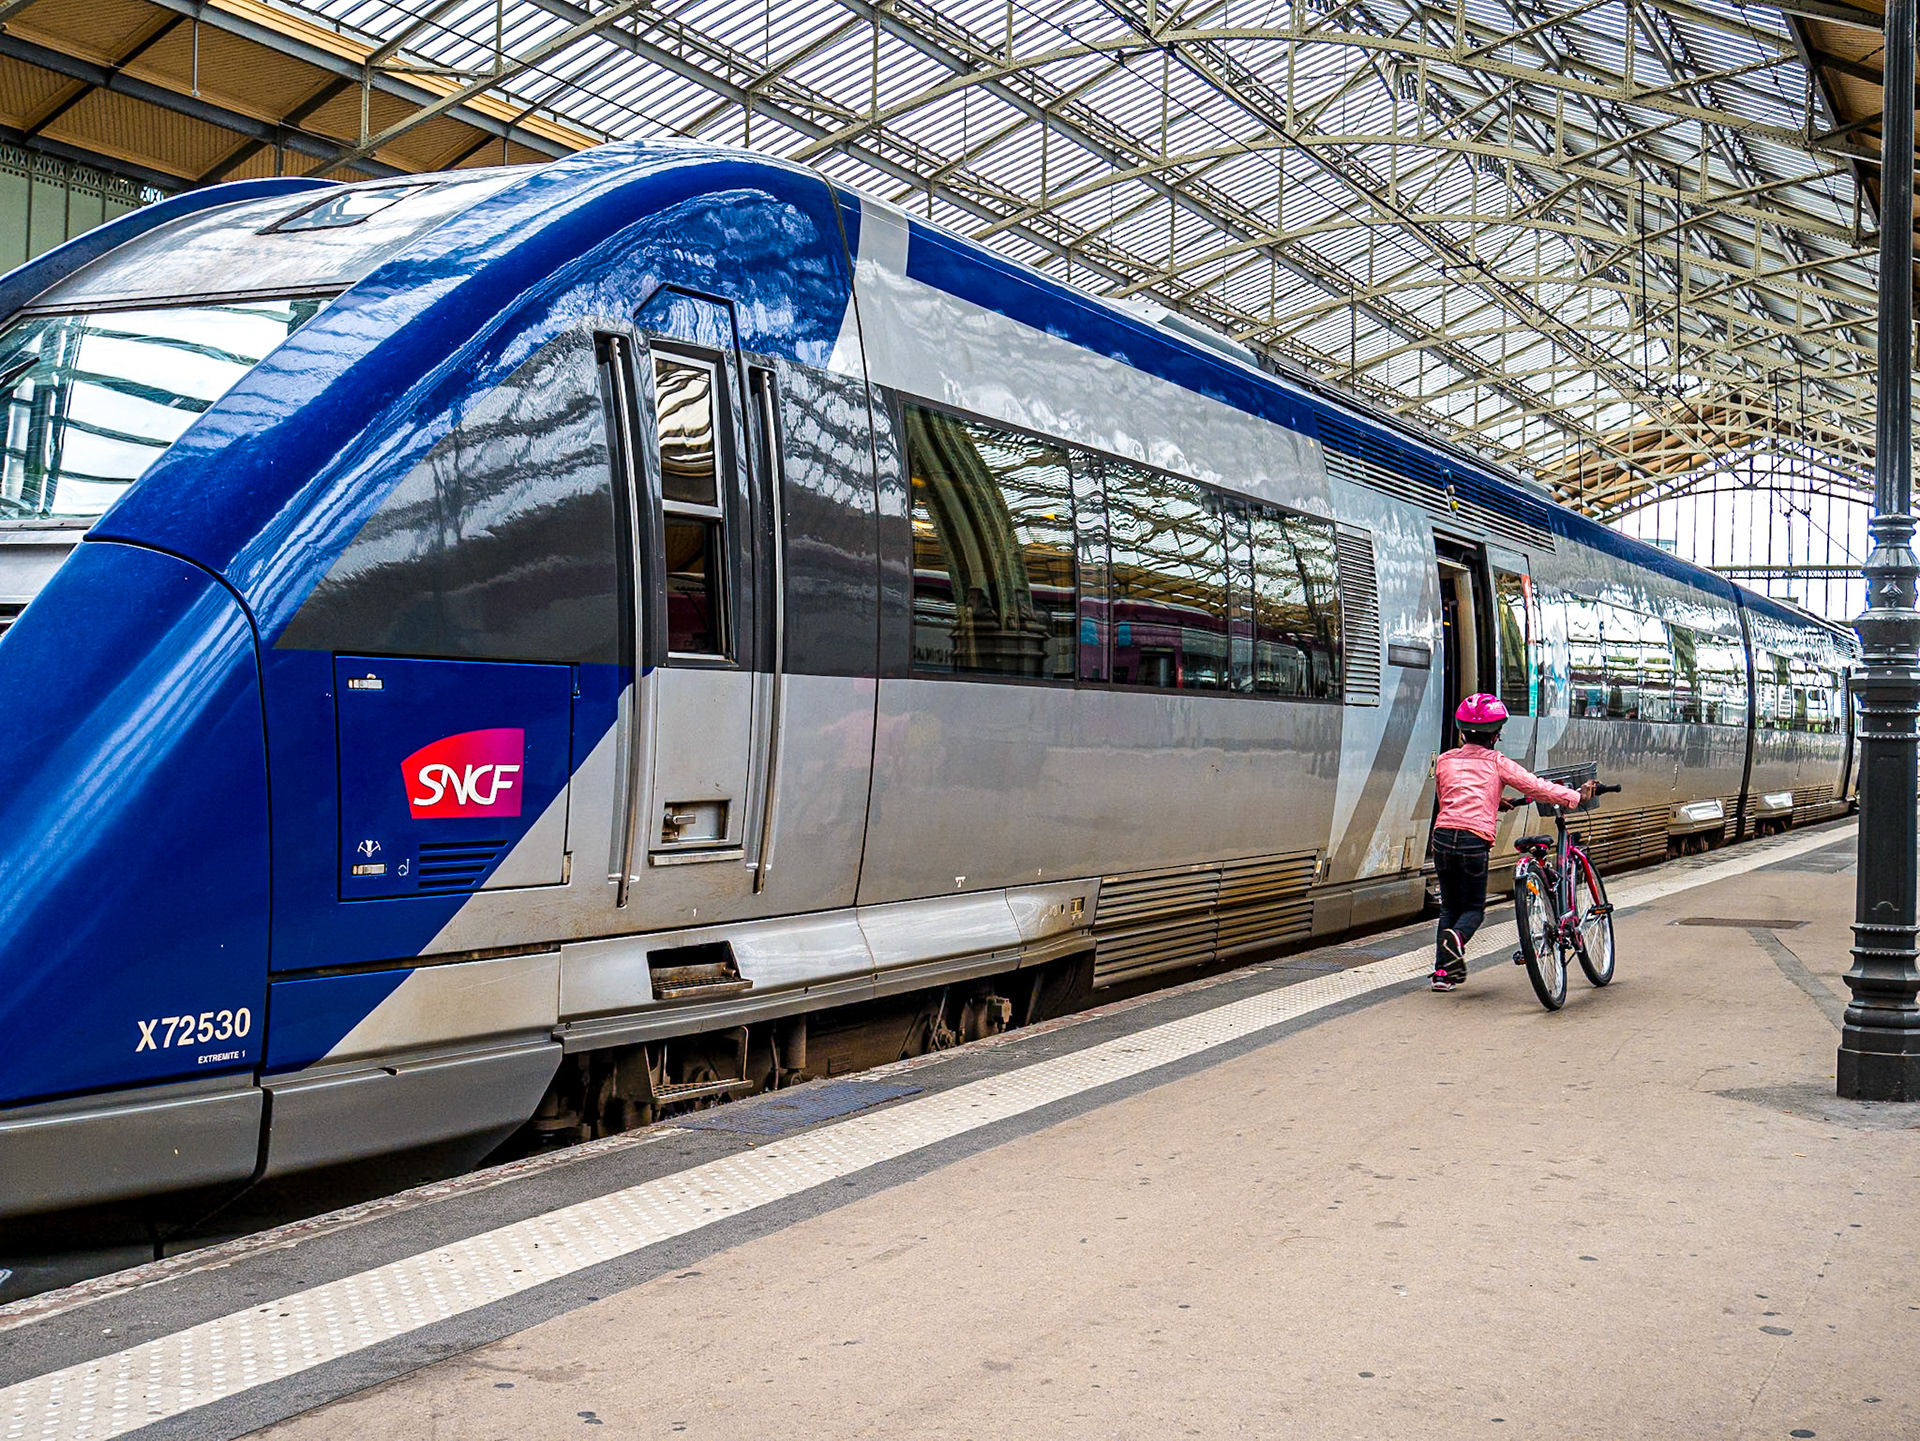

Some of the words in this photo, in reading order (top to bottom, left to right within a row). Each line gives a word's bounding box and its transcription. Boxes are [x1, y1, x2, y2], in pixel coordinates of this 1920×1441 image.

[413, 763, 520, 806] SNCF
[135, 1007, 251, 1052] X72530
[198, 1050, 239, 1064] EXTREMITE
[241, 1050, 246, 1058] 1
